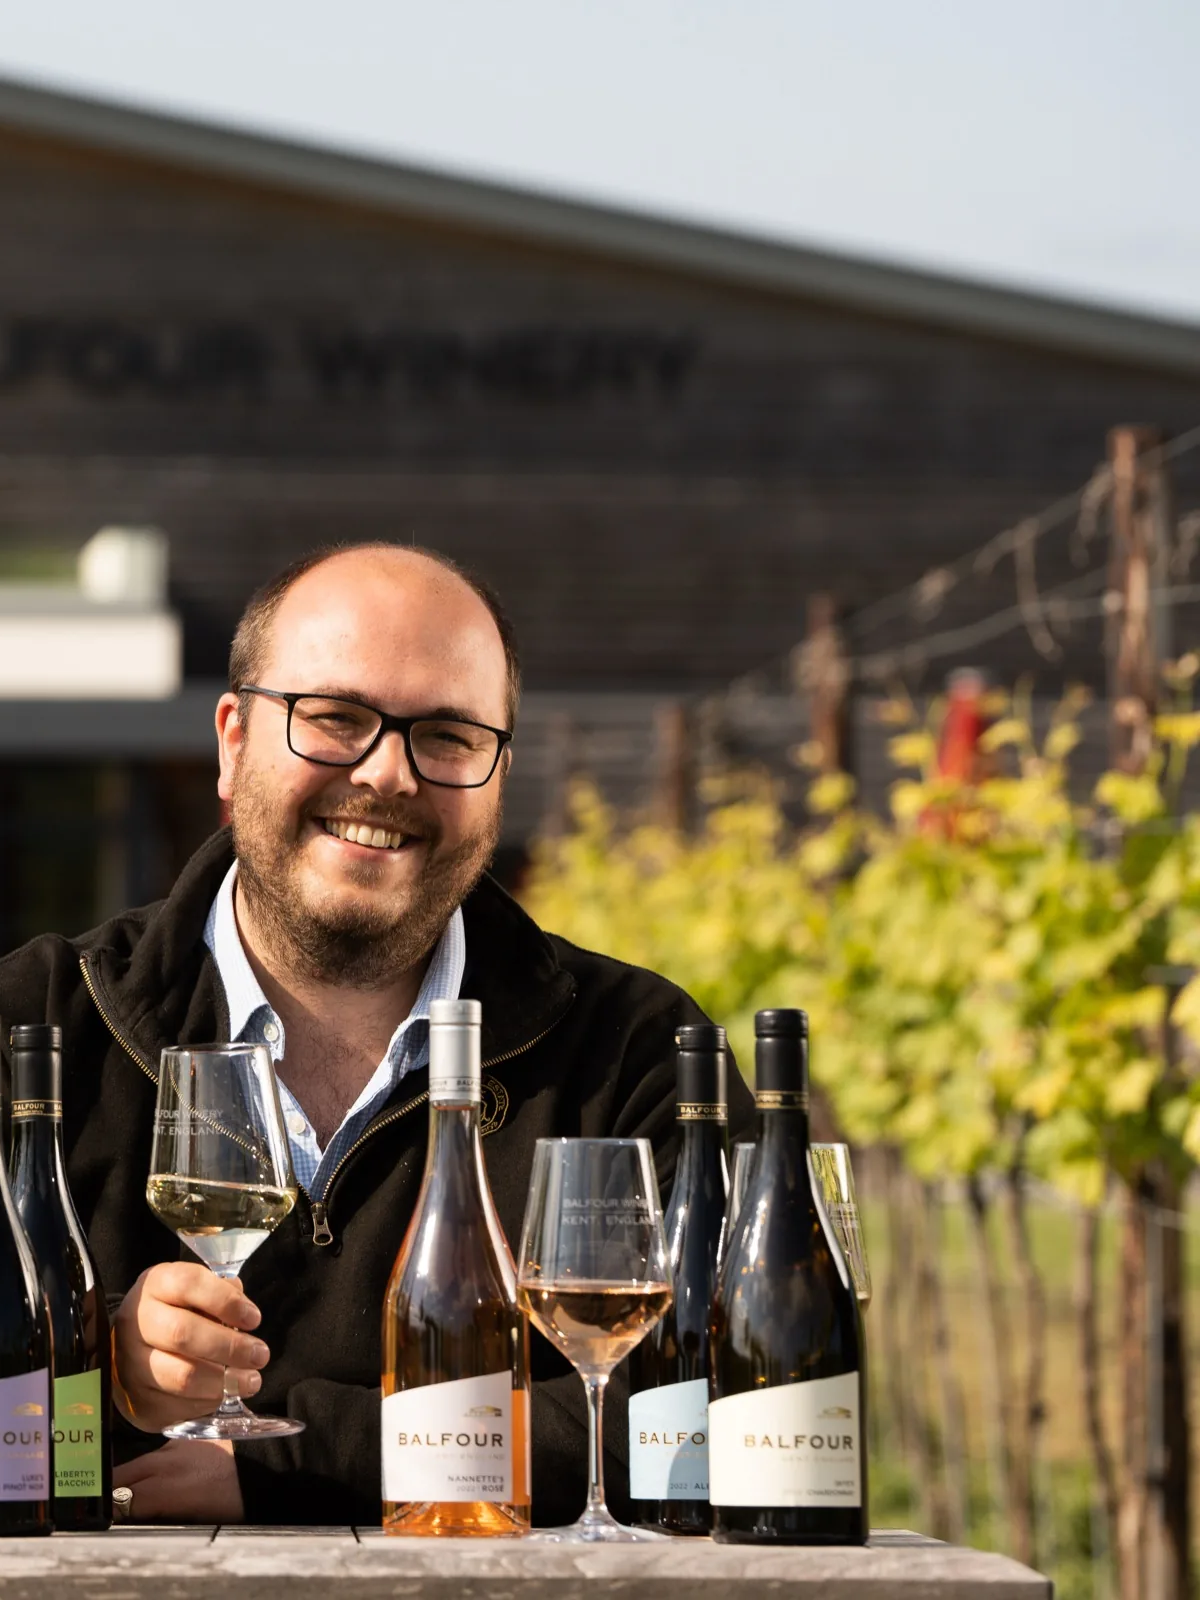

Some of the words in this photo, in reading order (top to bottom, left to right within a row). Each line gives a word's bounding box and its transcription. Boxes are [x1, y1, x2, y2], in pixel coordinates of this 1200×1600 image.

[299, 324, 702, 396] WINERY
[13, 1103, 45, 1111] BALFOUR
[680, 1106, 722, 1114] BALFOUR
[562, 1199, 619, 1208] BALFOUR
[398, 1433, 504, 1447] BALFOUR
[744, 1434, 854, 1450] BALFOUR
[55, 1470, 96, 1478] LIBERTY'S
[58, 1479, 96, 1487] BACCHUS
[447, 1475, 505, 1483] NANNETTE'S
